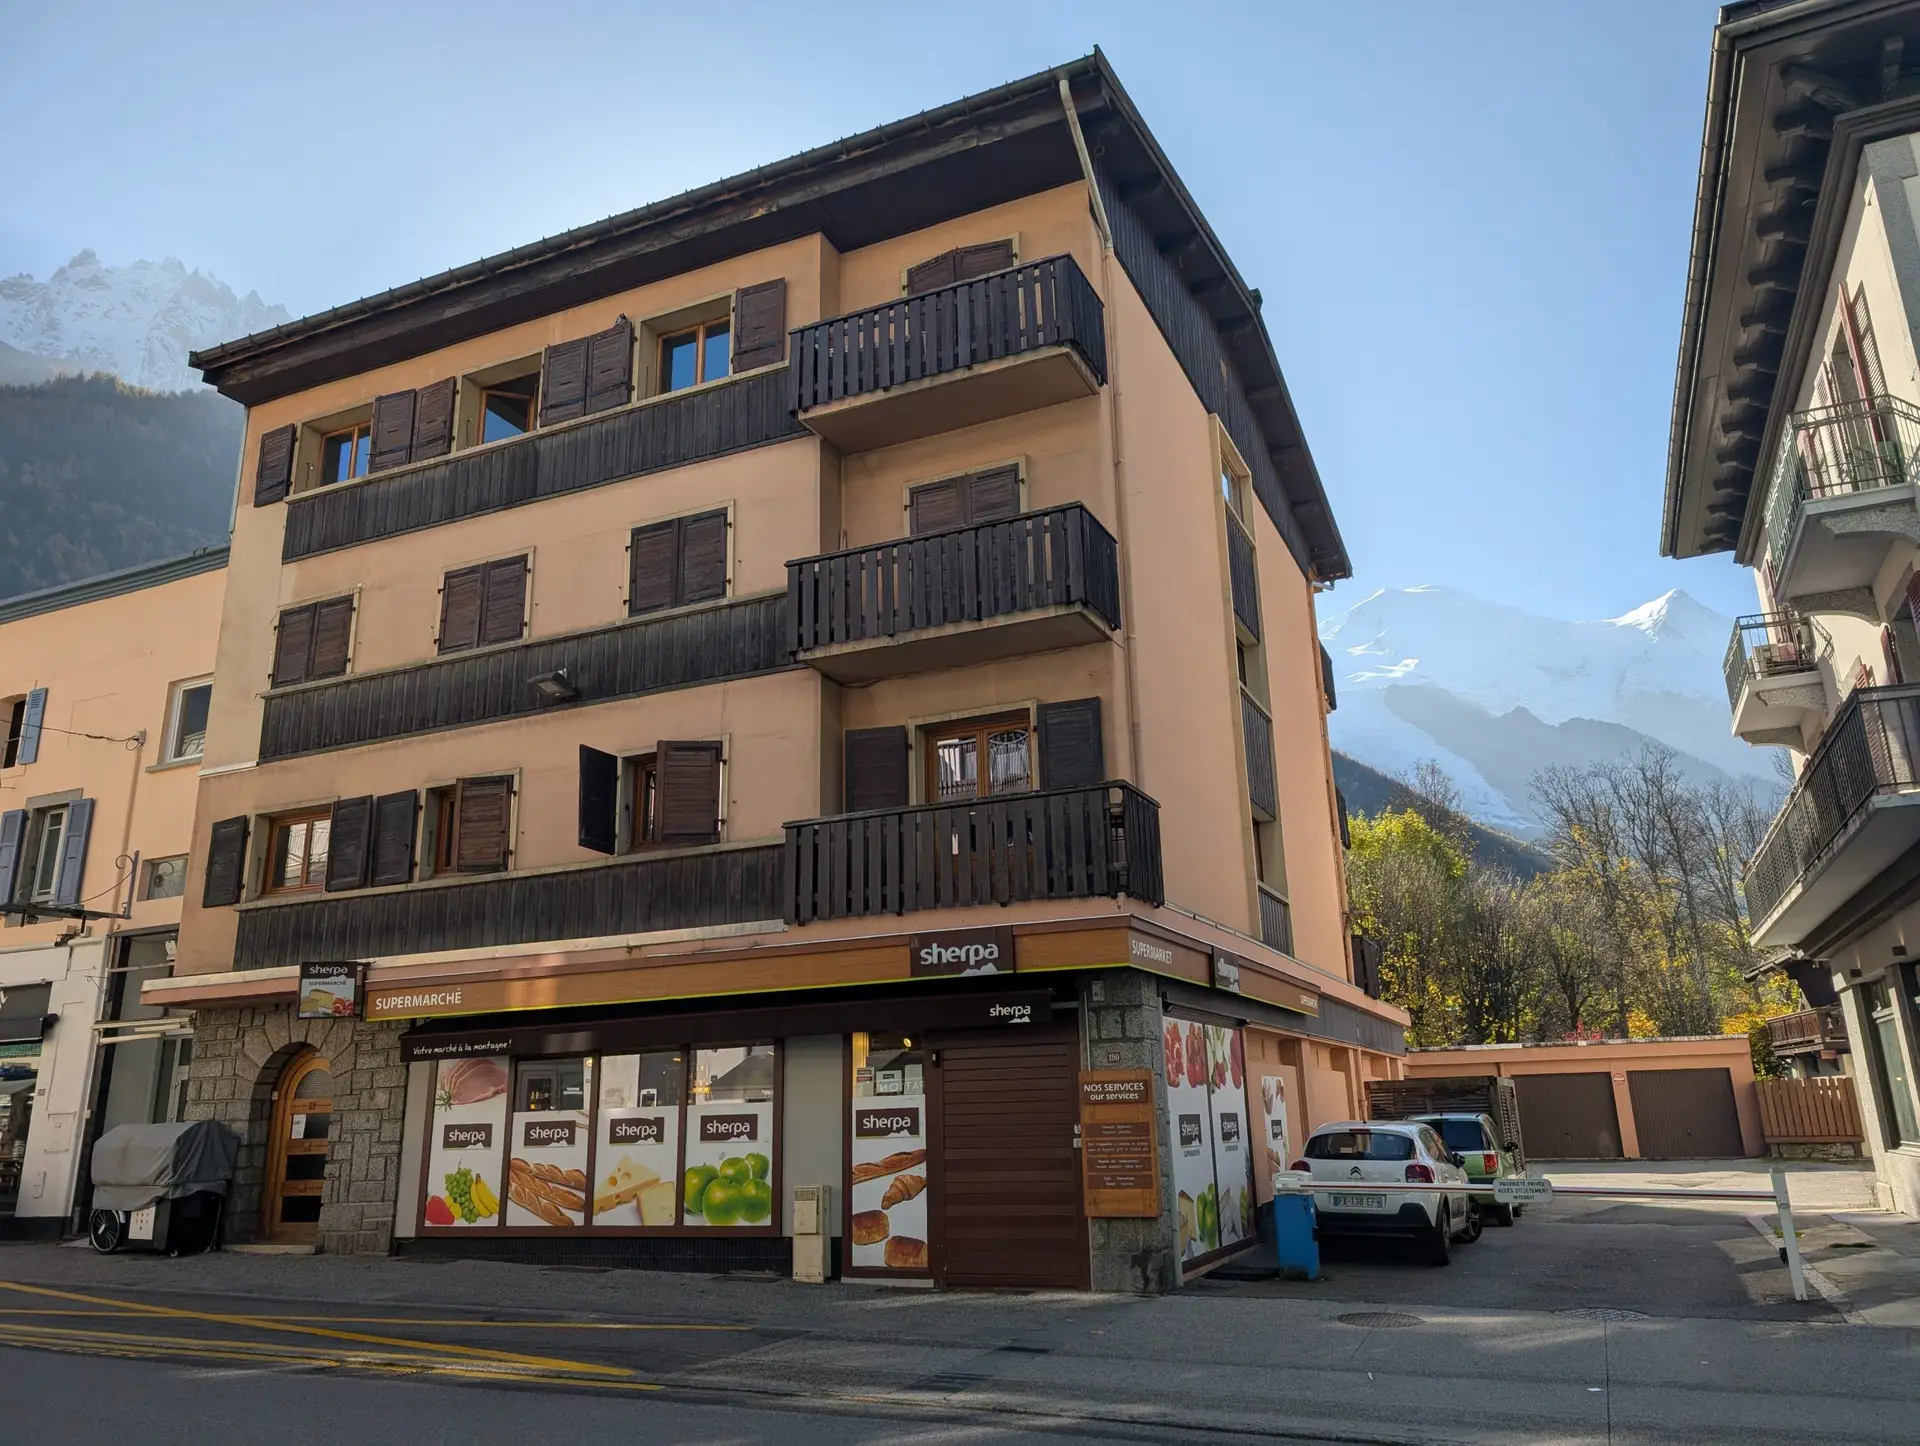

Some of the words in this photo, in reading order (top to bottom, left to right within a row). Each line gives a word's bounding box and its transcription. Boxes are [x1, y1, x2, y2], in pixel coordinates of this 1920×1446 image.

[920, 943, 999, 966] sherpa
[1132, 939, 1172, 965] SUPERMARKET
[309, 964, 348, 975] sherpa
[375, 988, 462, 1010] SUPERMARCHÉ
[989, 1003, 1031, 1017] sherpa
[413, 1046, 432, 1055] Votre
[433, 1043, 457, 1053] marché
[458, 1044, 463, 1052] à
[464, 1043, 472, 1051] la
[473, 1041, 507, 1051] montagne
[1108, 1053, 1120, 1061] 190
[1084, 1084, 1102, 1092] NOS
[1104, 1082, 1144, 1092] SERVICES
[1090, 1093, 1104, 1101] our
[1106, 1092, 1139, 1100] services
[706, 1120, 750, 1135] sherpa
[862, 1114, 911, 1130] sherpa
[1182, 1120, 1199, 1139] sherpa
[449, 1128, 486, 1143] sherpa
[529, 1126, 569, 1140] sherpa
[615, 1123, 657, 1138] sherpa
